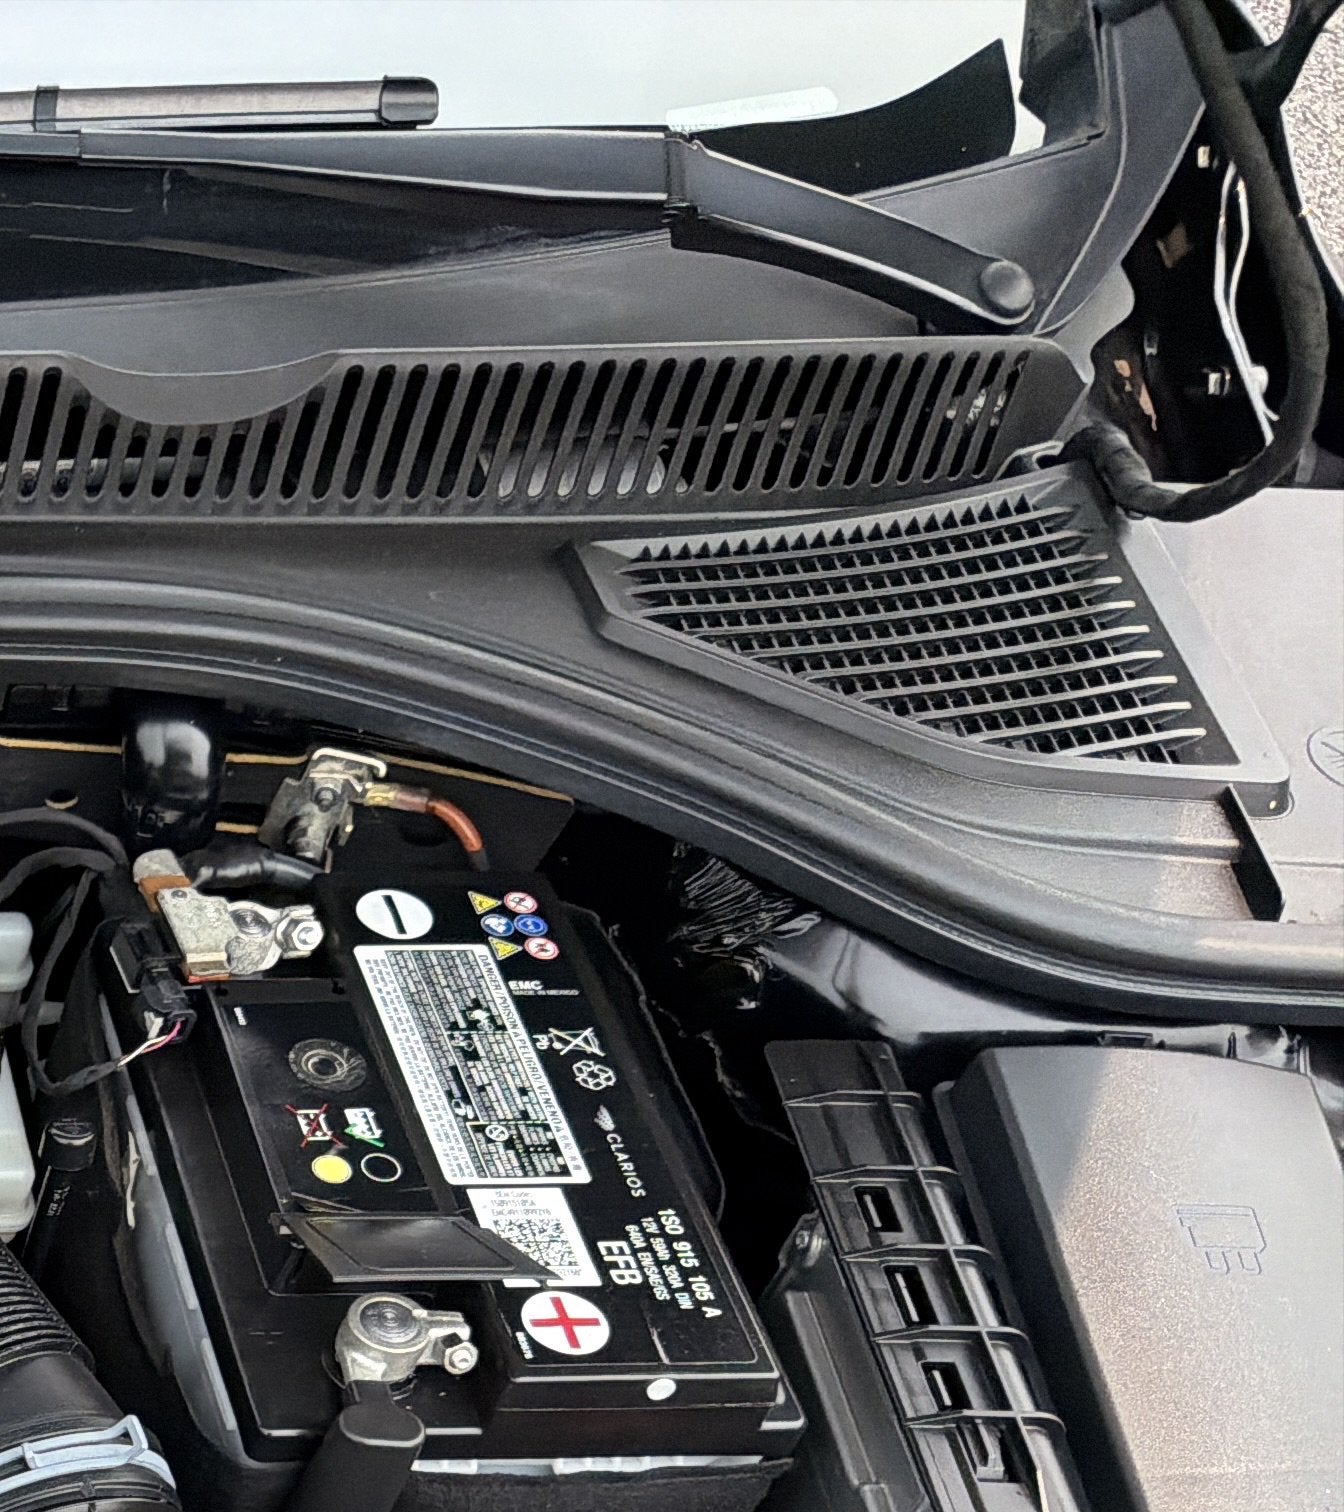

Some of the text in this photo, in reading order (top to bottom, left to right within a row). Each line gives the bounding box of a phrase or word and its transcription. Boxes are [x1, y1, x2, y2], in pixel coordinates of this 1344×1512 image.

[508, 980, 543, 990] EMC
[606, 1133, 646, 1198] CLARIOS
[596, 1241, 643, 1285] EFB
[640, 1217, 661, 1234] 12V
[675, 1292, 695, 1310] DIN
[673, 1241, 700, 1268] 915
[689, 1275, 715, 1301] 105
[702, 1306, 723, 1319] A
